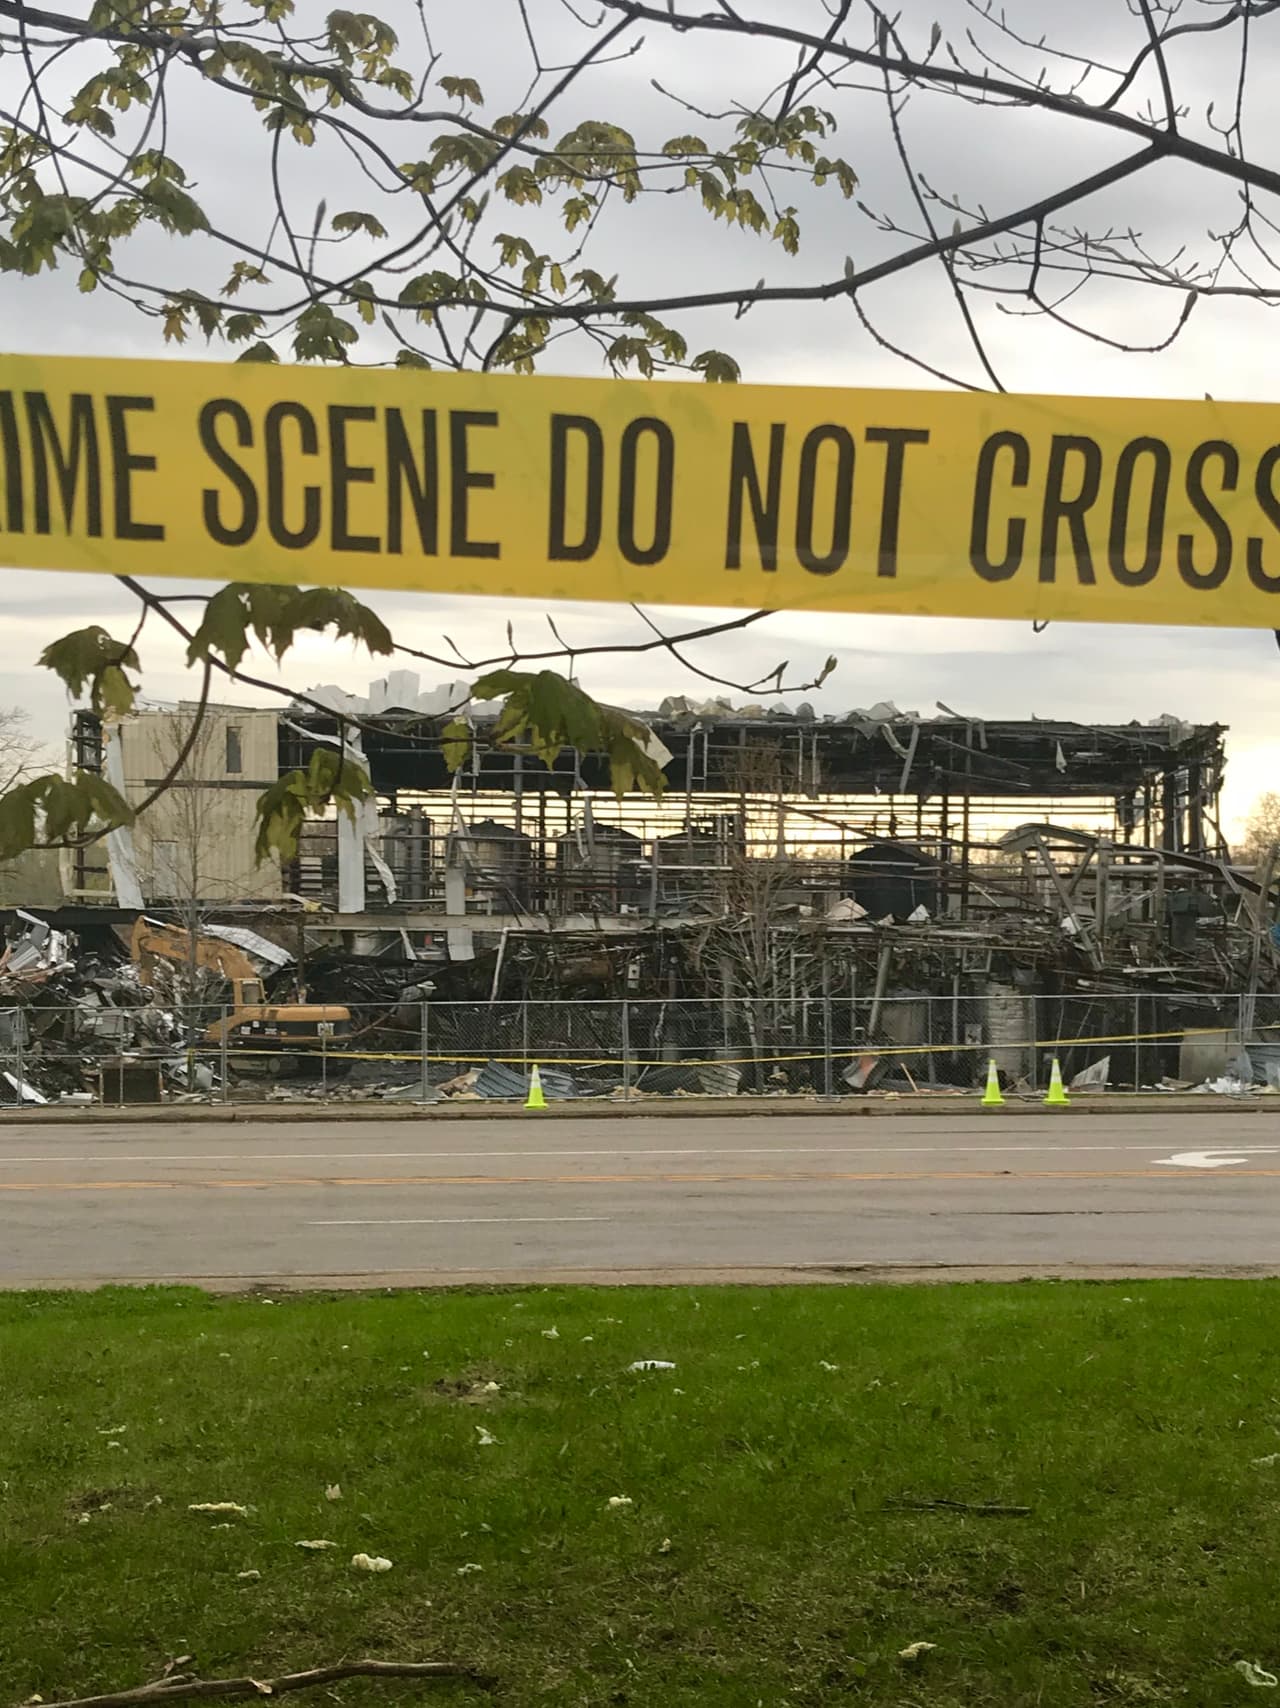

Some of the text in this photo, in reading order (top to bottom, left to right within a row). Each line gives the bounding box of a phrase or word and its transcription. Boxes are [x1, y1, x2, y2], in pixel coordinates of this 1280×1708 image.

[0, 389, 1280, 593] IME SCENE DO NOT CROSS
